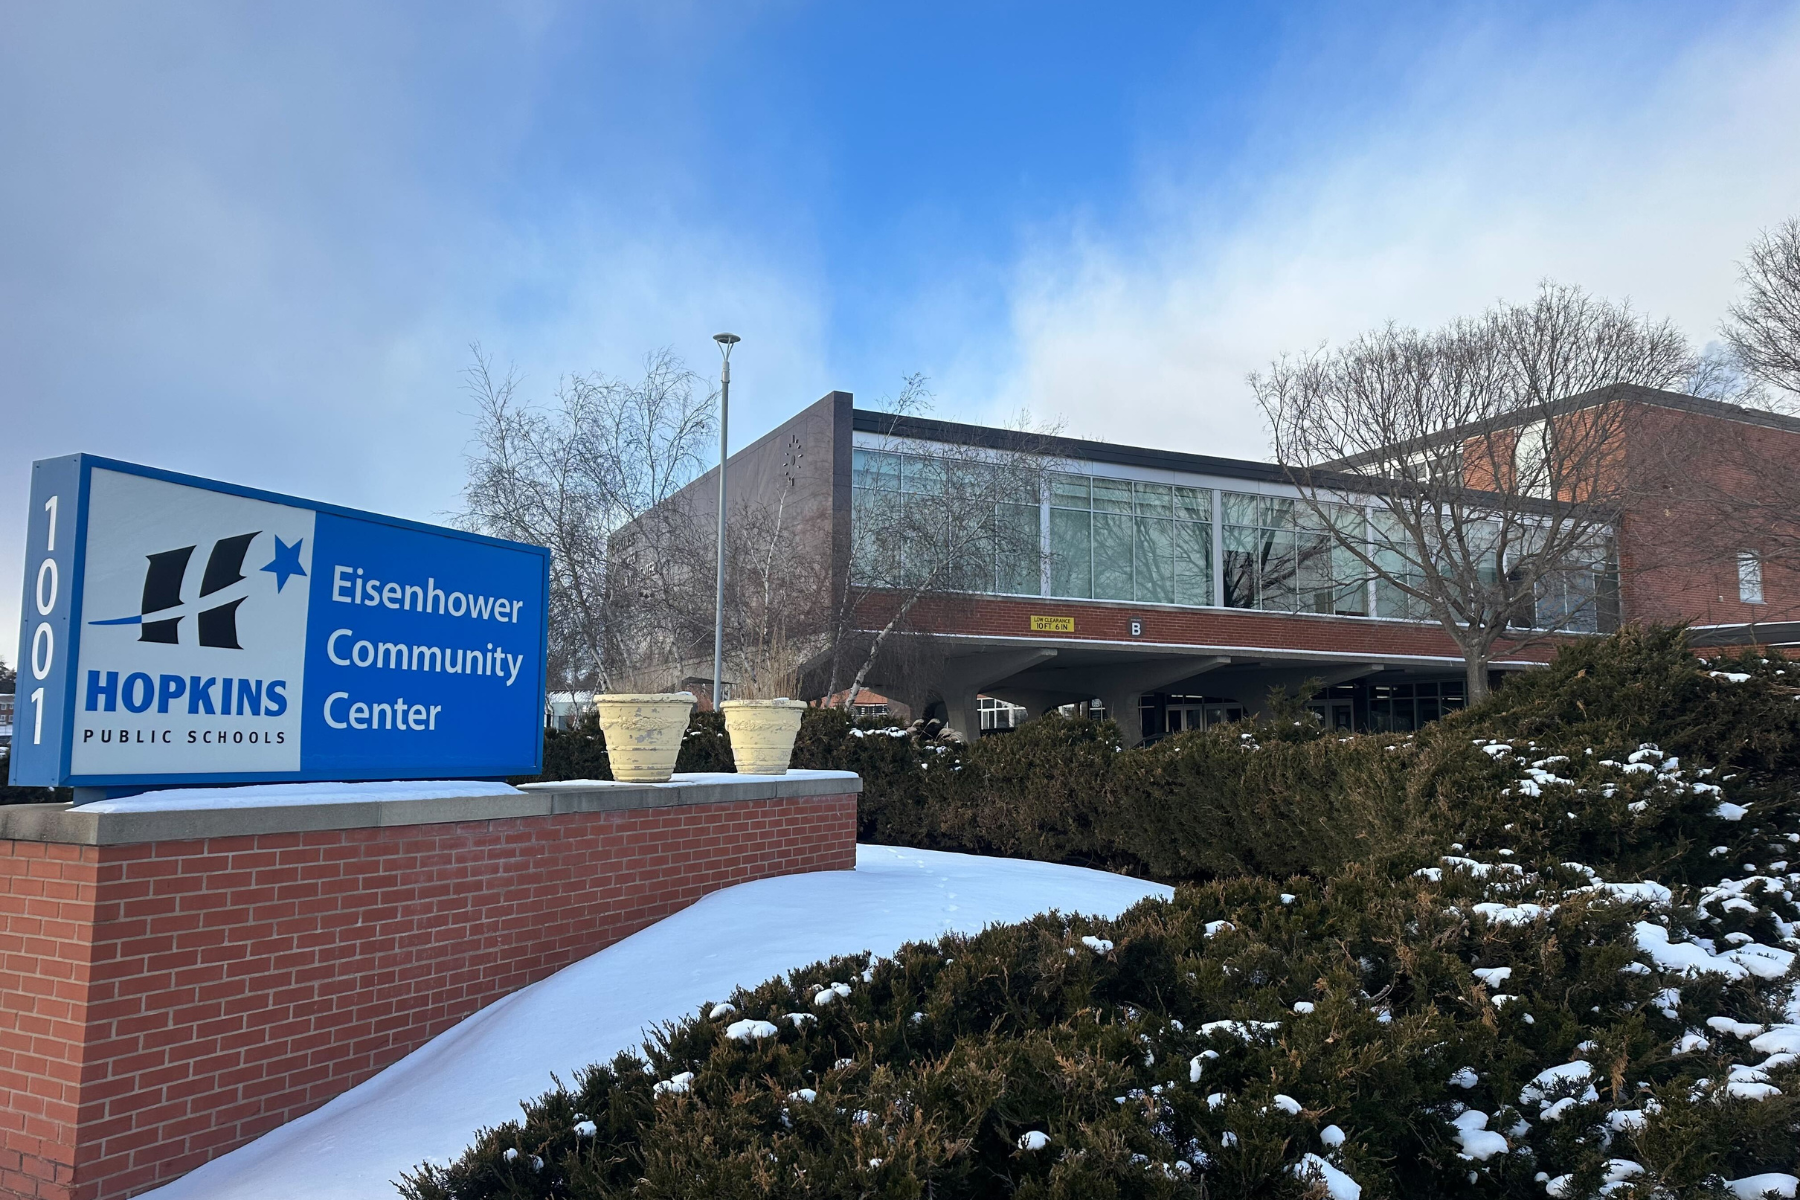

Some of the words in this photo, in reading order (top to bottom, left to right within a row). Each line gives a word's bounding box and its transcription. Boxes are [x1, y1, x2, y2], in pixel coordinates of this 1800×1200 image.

[332, 565, 523, 623] Eisenhower
[31, 495, 58, 745] 1001
[1131, 622, 1141, 636] B
[326, 629, 524, 687] Community
[84, 669, 288, 717] HOPKINS
[323, 691, 442, 730] Center
[83, 729, 171, 743] PUBLIC
[187, 731, 286, 744] SCHOOLS
